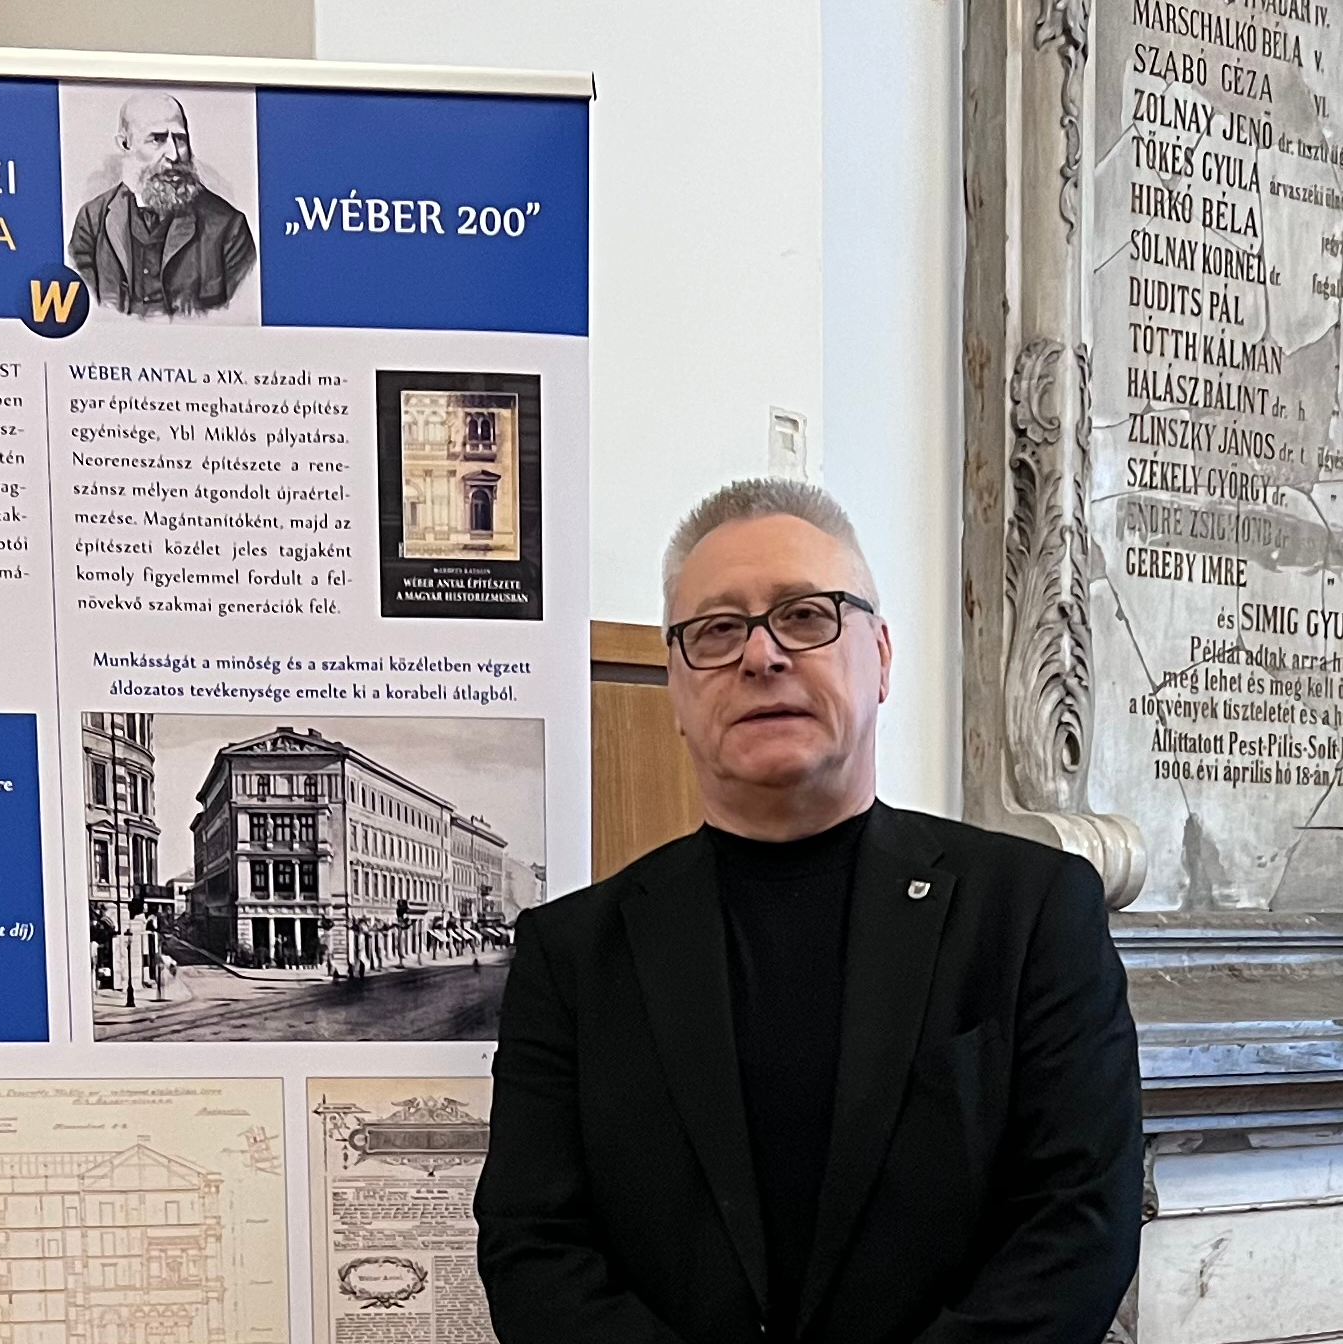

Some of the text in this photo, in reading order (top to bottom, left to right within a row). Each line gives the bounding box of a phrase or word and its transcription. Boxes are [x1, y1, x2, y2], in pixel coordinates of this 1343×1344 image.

[1133, 43, 1273, 103] SZABÓ GÉZA
[1133, 88, 1215, 136] ZOLNAY
[1202, 151, 1260, 194] GYULA
[1130, 182, 1258, 238] HIRKÓ BÉLA
[31, 280, 80, 323] W
[1129, 276, 1244, 325] DUDITS PÁL
[1129, 316, 1282, 375] TÓTTH KÁLMÁN
[67, 363, 349, 386] WÉBER ANTAL a XIX. századi ma-
[1127, 364, 1269, 416] HALÁSZ BÁLINT
[1125, 541, 1247, 588] GERÉBY IMRE
[1217, 606, 1235, 629] és
[1241, 602, 1299, 635] SIMIG
[1197, 758, 1219, 782] évi
[1223, 758, 1272, 789] április
[1275, 760, 1292, 785] hó
[8, 920, 35, 942] díj)
